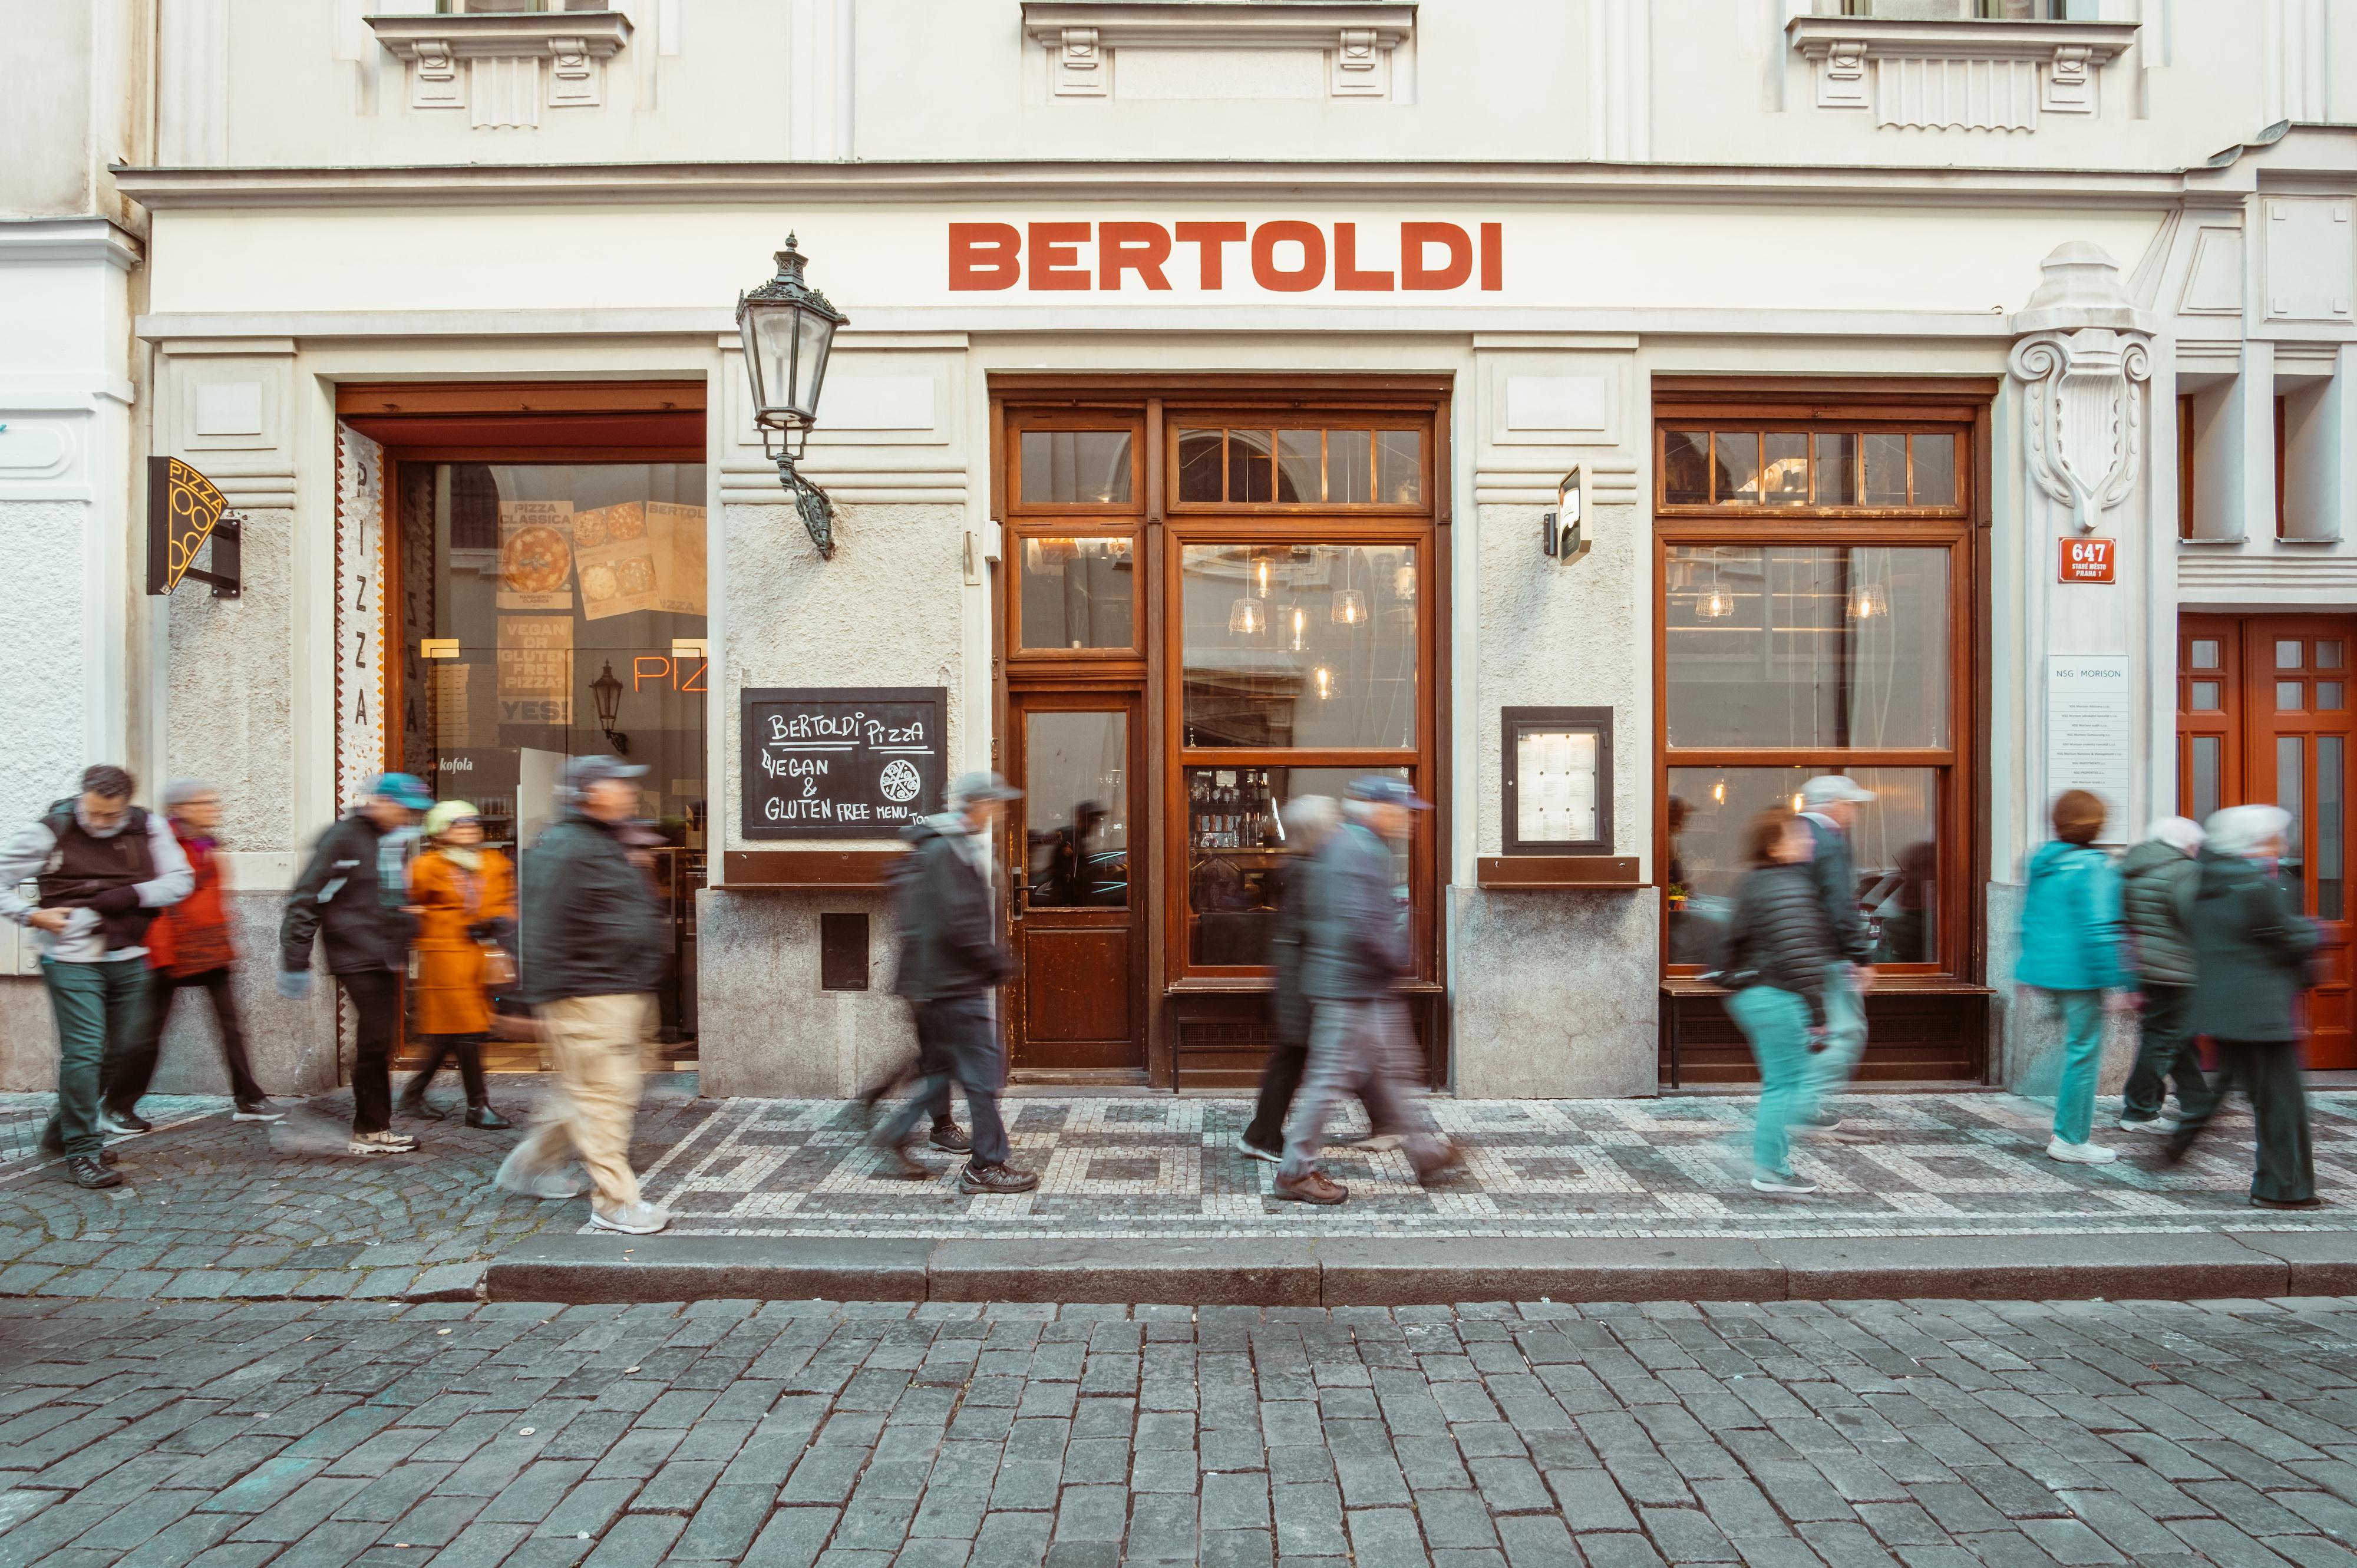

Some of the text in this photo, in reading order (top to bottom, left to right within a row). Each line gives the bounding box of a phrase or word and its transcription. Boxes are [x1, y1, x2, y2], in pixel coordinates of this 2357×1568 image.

[949, 220, 1501, 291] BERTOLDI
[169, 463, 223, 514] PIZZA
[514, 503, 557, 513] PIZZA
[648, 504, 707, 519] BERTOL
[499, 514, 571, 524] CLASSICA
[2072, 543, 2105, 562] 647
[355, 461, 367, 725] PIZZA
[659, 599, 695, 612] IZZA
[506, 623, 566, 636] VEGAN
[523, 636, 548, 649] OR
[500, 650, 573, 662] GLUTEN
[513, 663, 557, 675] FREE
[505, 676, 566, 688] PIZZA?
[501, 701, 569, 721] YES!
[440, 758, 473, 774] kofola
[762, 750, 828, 778] VEGAN
[803, 777, 817, 797] &
[765, 797, 832, 821] GLUTEN
[836, 803, 871, 822] FREE
[876, 806, 907, 820] MENU
